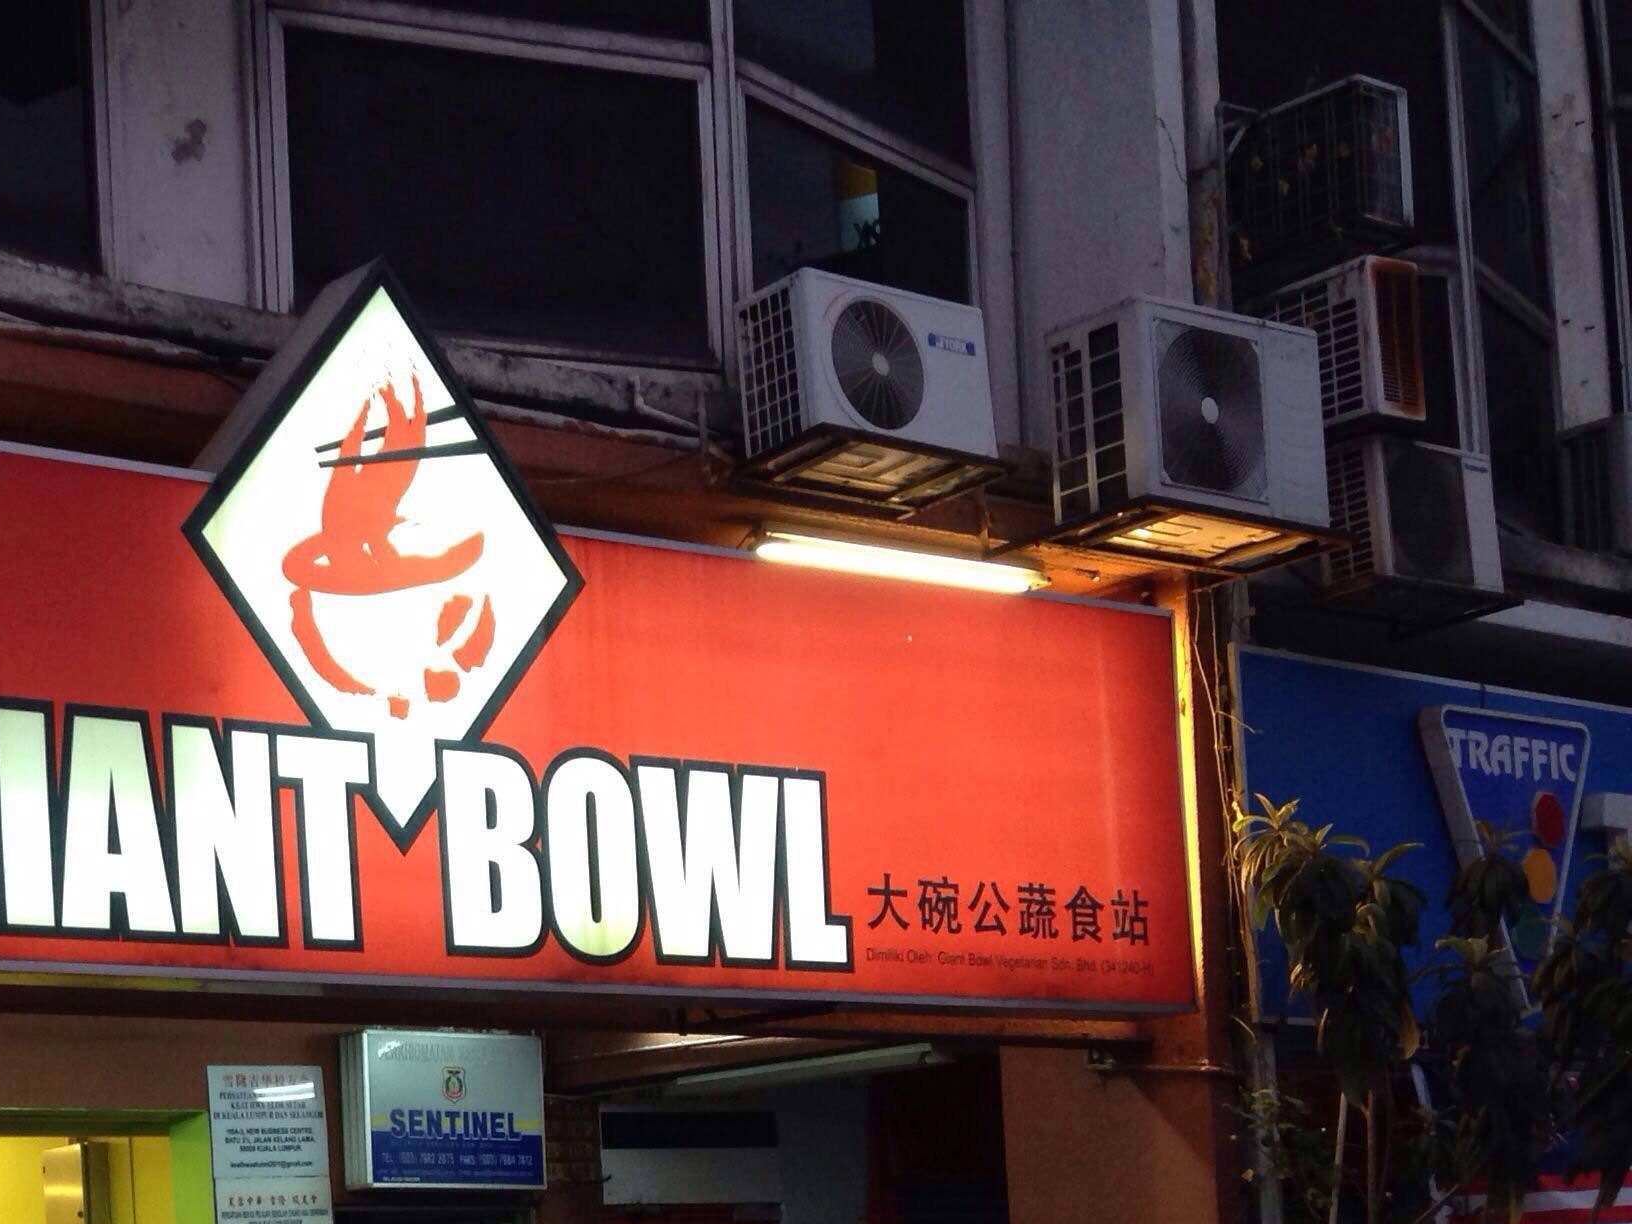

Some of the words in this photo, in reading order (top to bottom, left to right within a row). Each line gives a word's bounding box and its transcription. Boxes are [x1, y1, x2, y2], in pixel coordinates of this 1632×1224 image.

[1445, 727, 1576, 782] TRAFFIC
[435, 739, 853, 973] BOWL
[867, 872, 1150, 946] 大碗公蔬食站
[968, 952, 993, 967] Bowl
[390, 1109, 522, 1141] SENTINEL
